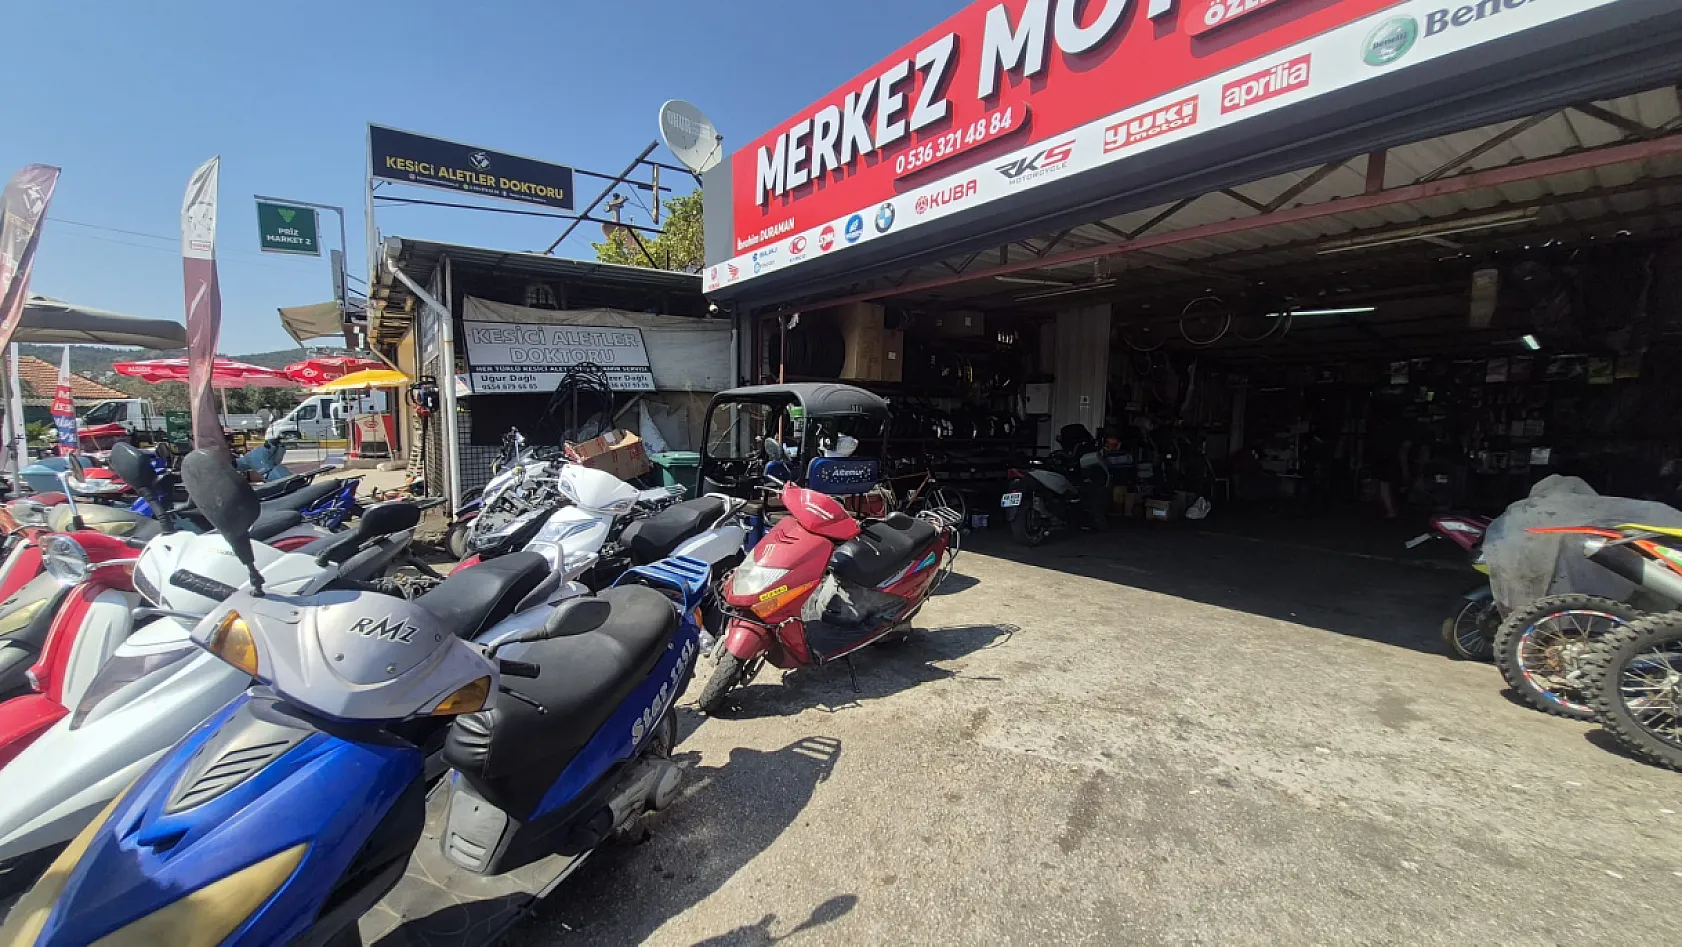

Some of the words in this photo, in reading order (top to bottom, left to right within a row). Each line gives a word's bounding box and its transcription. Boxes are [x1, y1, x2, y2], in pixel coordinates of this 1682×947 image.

[1223, 61, 1309, 107] aprilia
[756, 32, 955, 206] MERKEZ
[978, 0, 1172, 99] MO
[895, 157, 906, 174] 0
[906, 141, 933, 170] 536
[935, 128, 962, 158] 321
[963, 116, 986, 144] 48
[989, 106, 1013, 134] 84
[1104, 100, 1194, 150] yuki
[1129, 115, 1193, 143] motor
[994, 138, 1077, 179] RKS
[438, 166, 496, 187] ALETLER
[499, 178, 564, 200] DOKTORU
[929, 179, 978, 210] KUBA
[266, 233, 304, 245] MARKET
[304, 237, 312, 245] 2
[509, 347, 616, 364] DOKTORU
[553, 331, 639, 348] ALETLER
